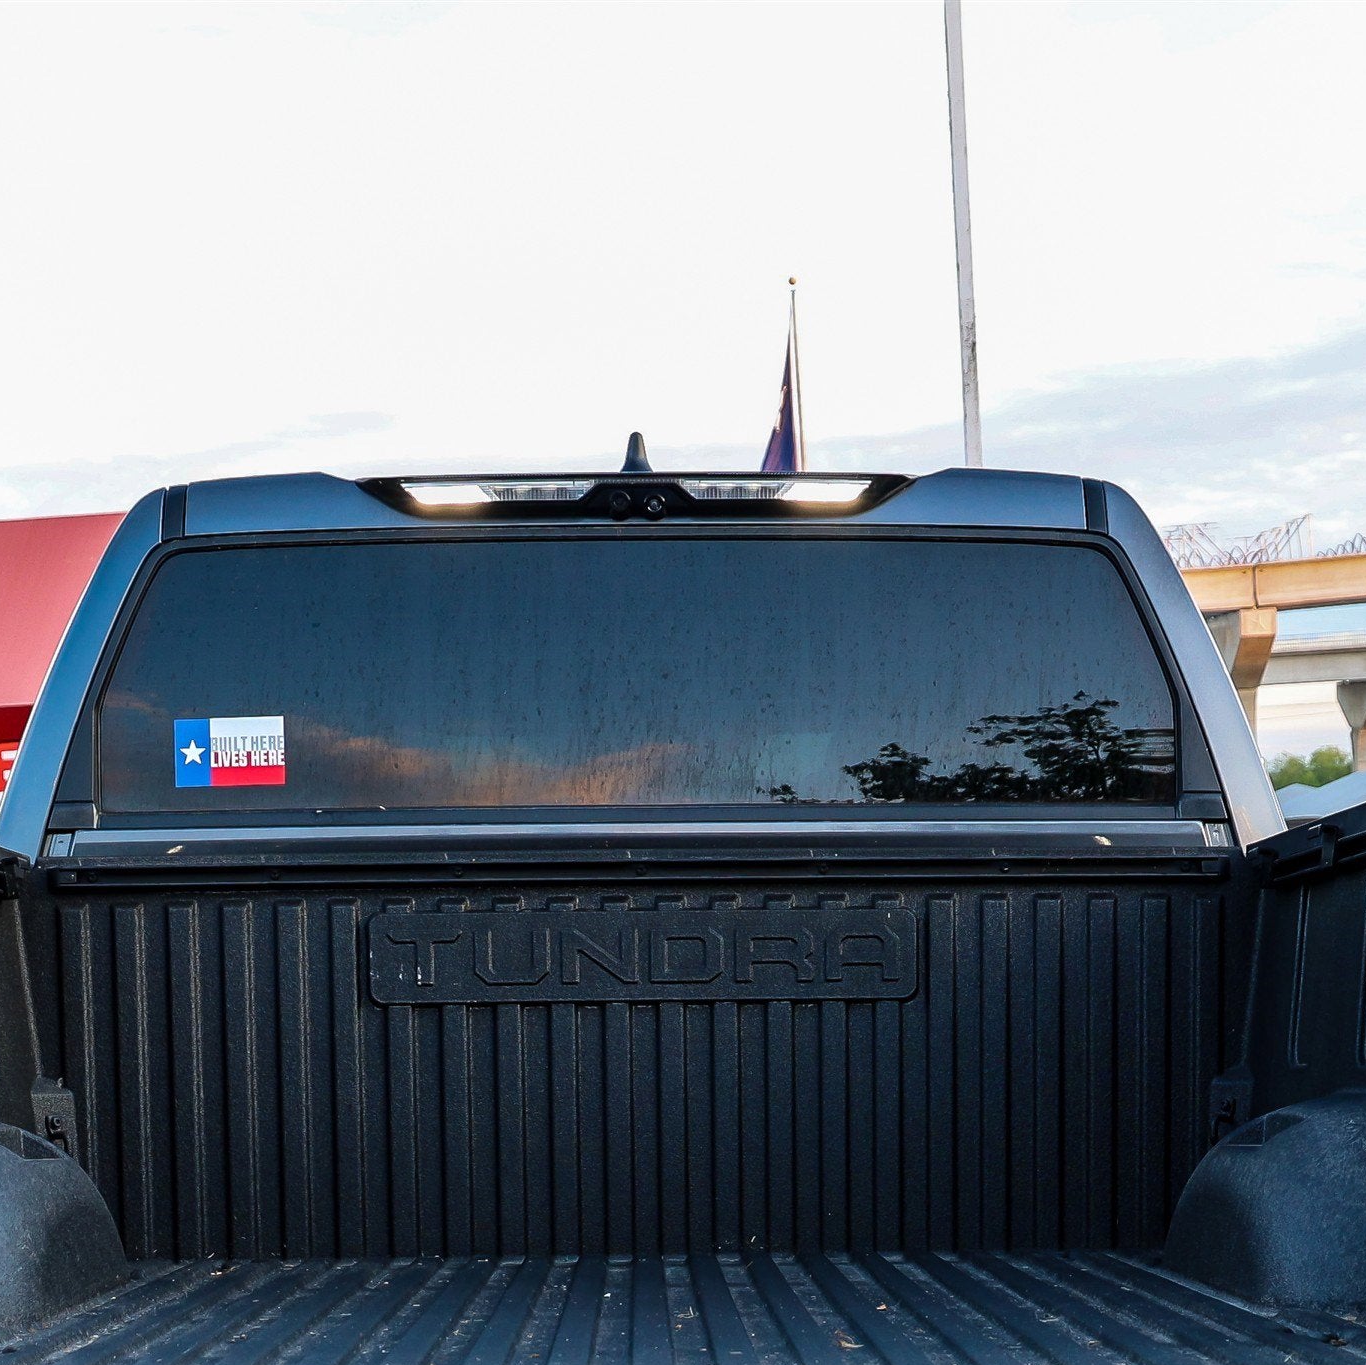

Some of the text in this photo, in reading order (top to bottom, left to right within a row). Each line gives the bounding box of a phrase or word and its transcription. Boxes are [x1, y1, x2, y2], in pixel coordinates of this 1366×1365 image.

[210, 735, 285, 752] BUILT HERE
[210, 750, 285, 768] LIVES HERE
[385, 926, 903, 985] TUNDRA
